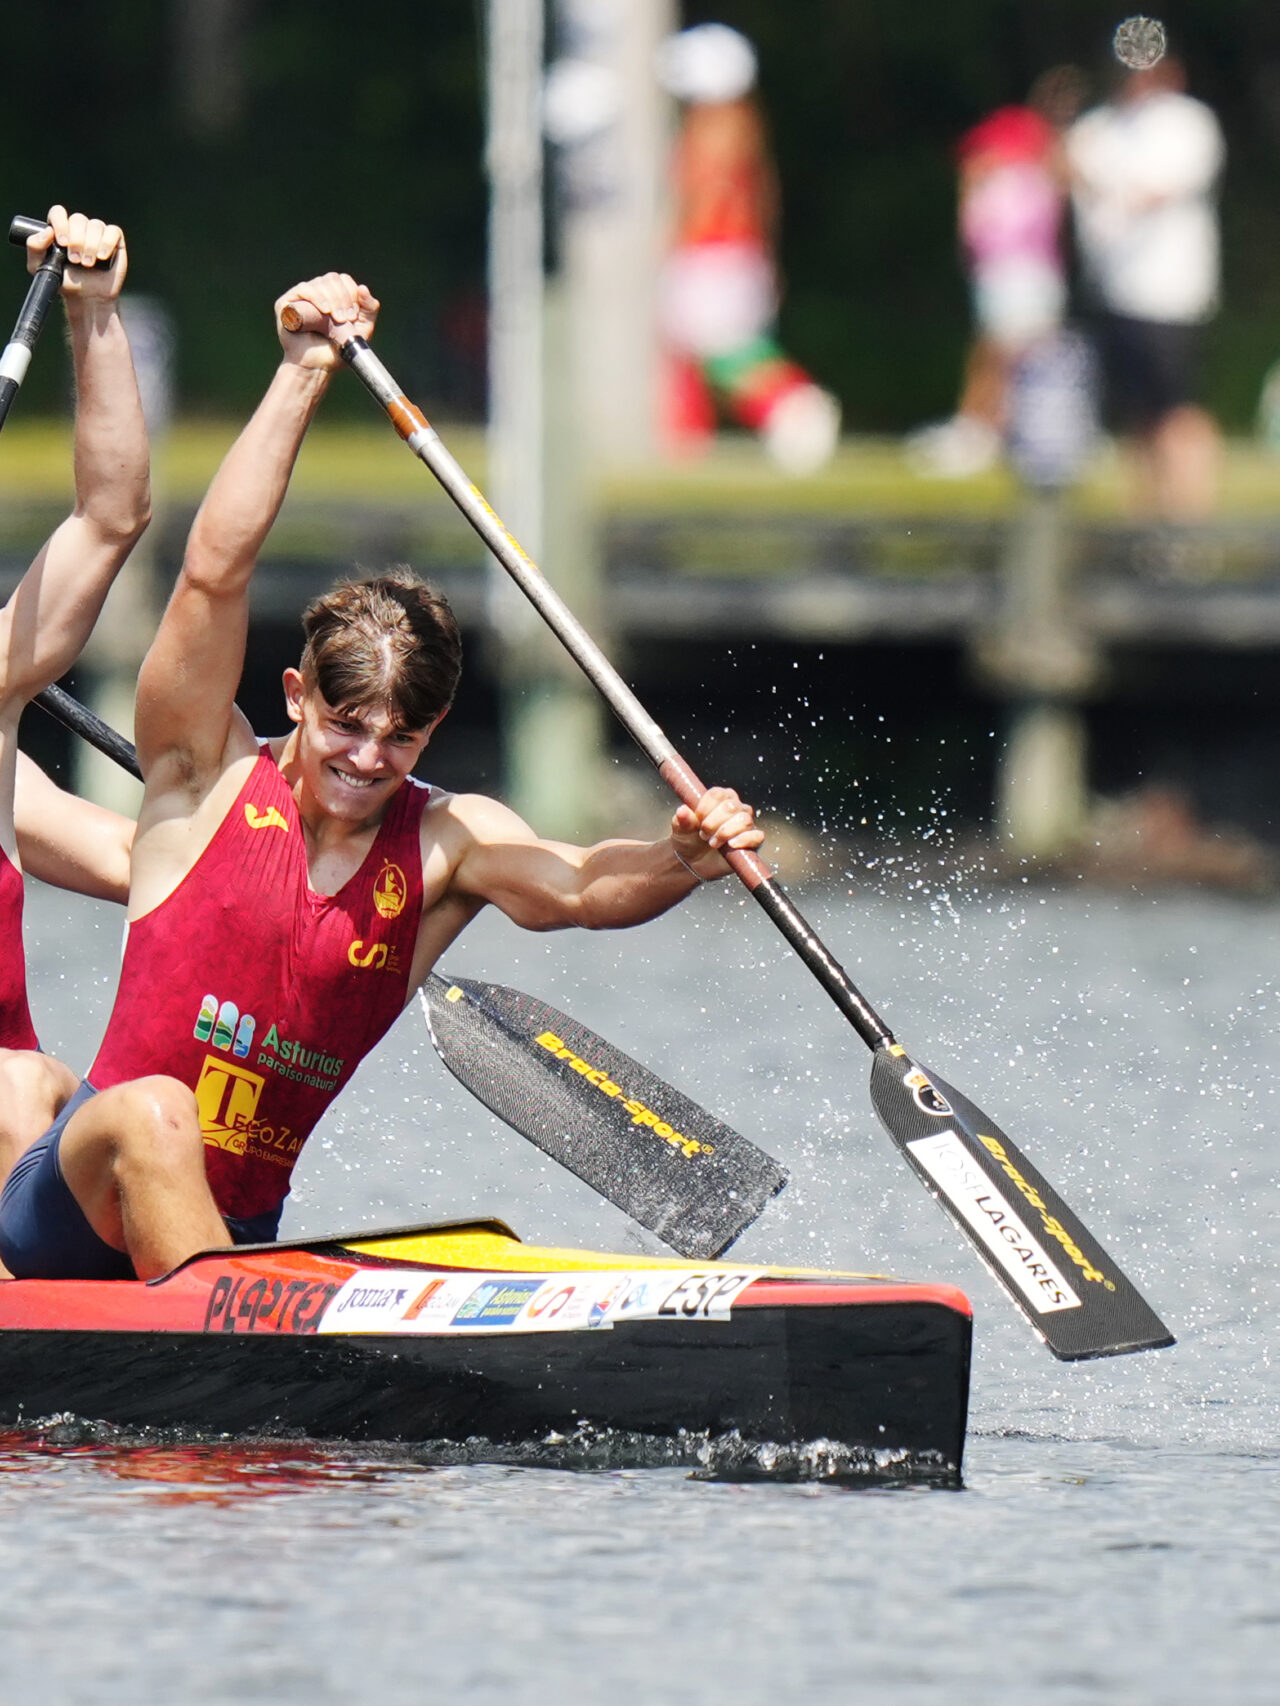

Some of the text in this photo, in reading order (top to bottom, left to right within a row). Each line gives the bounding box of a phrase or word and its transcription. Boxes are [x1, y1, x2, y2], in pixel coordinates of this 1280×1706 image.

[257, 1052, 337, 1092] paraíso natural
[261, 1023, 344, 1077] Asturias
[974, 1196, 1070, 1305] LAGARES
[657, 1274, 749, 1318] ESP
